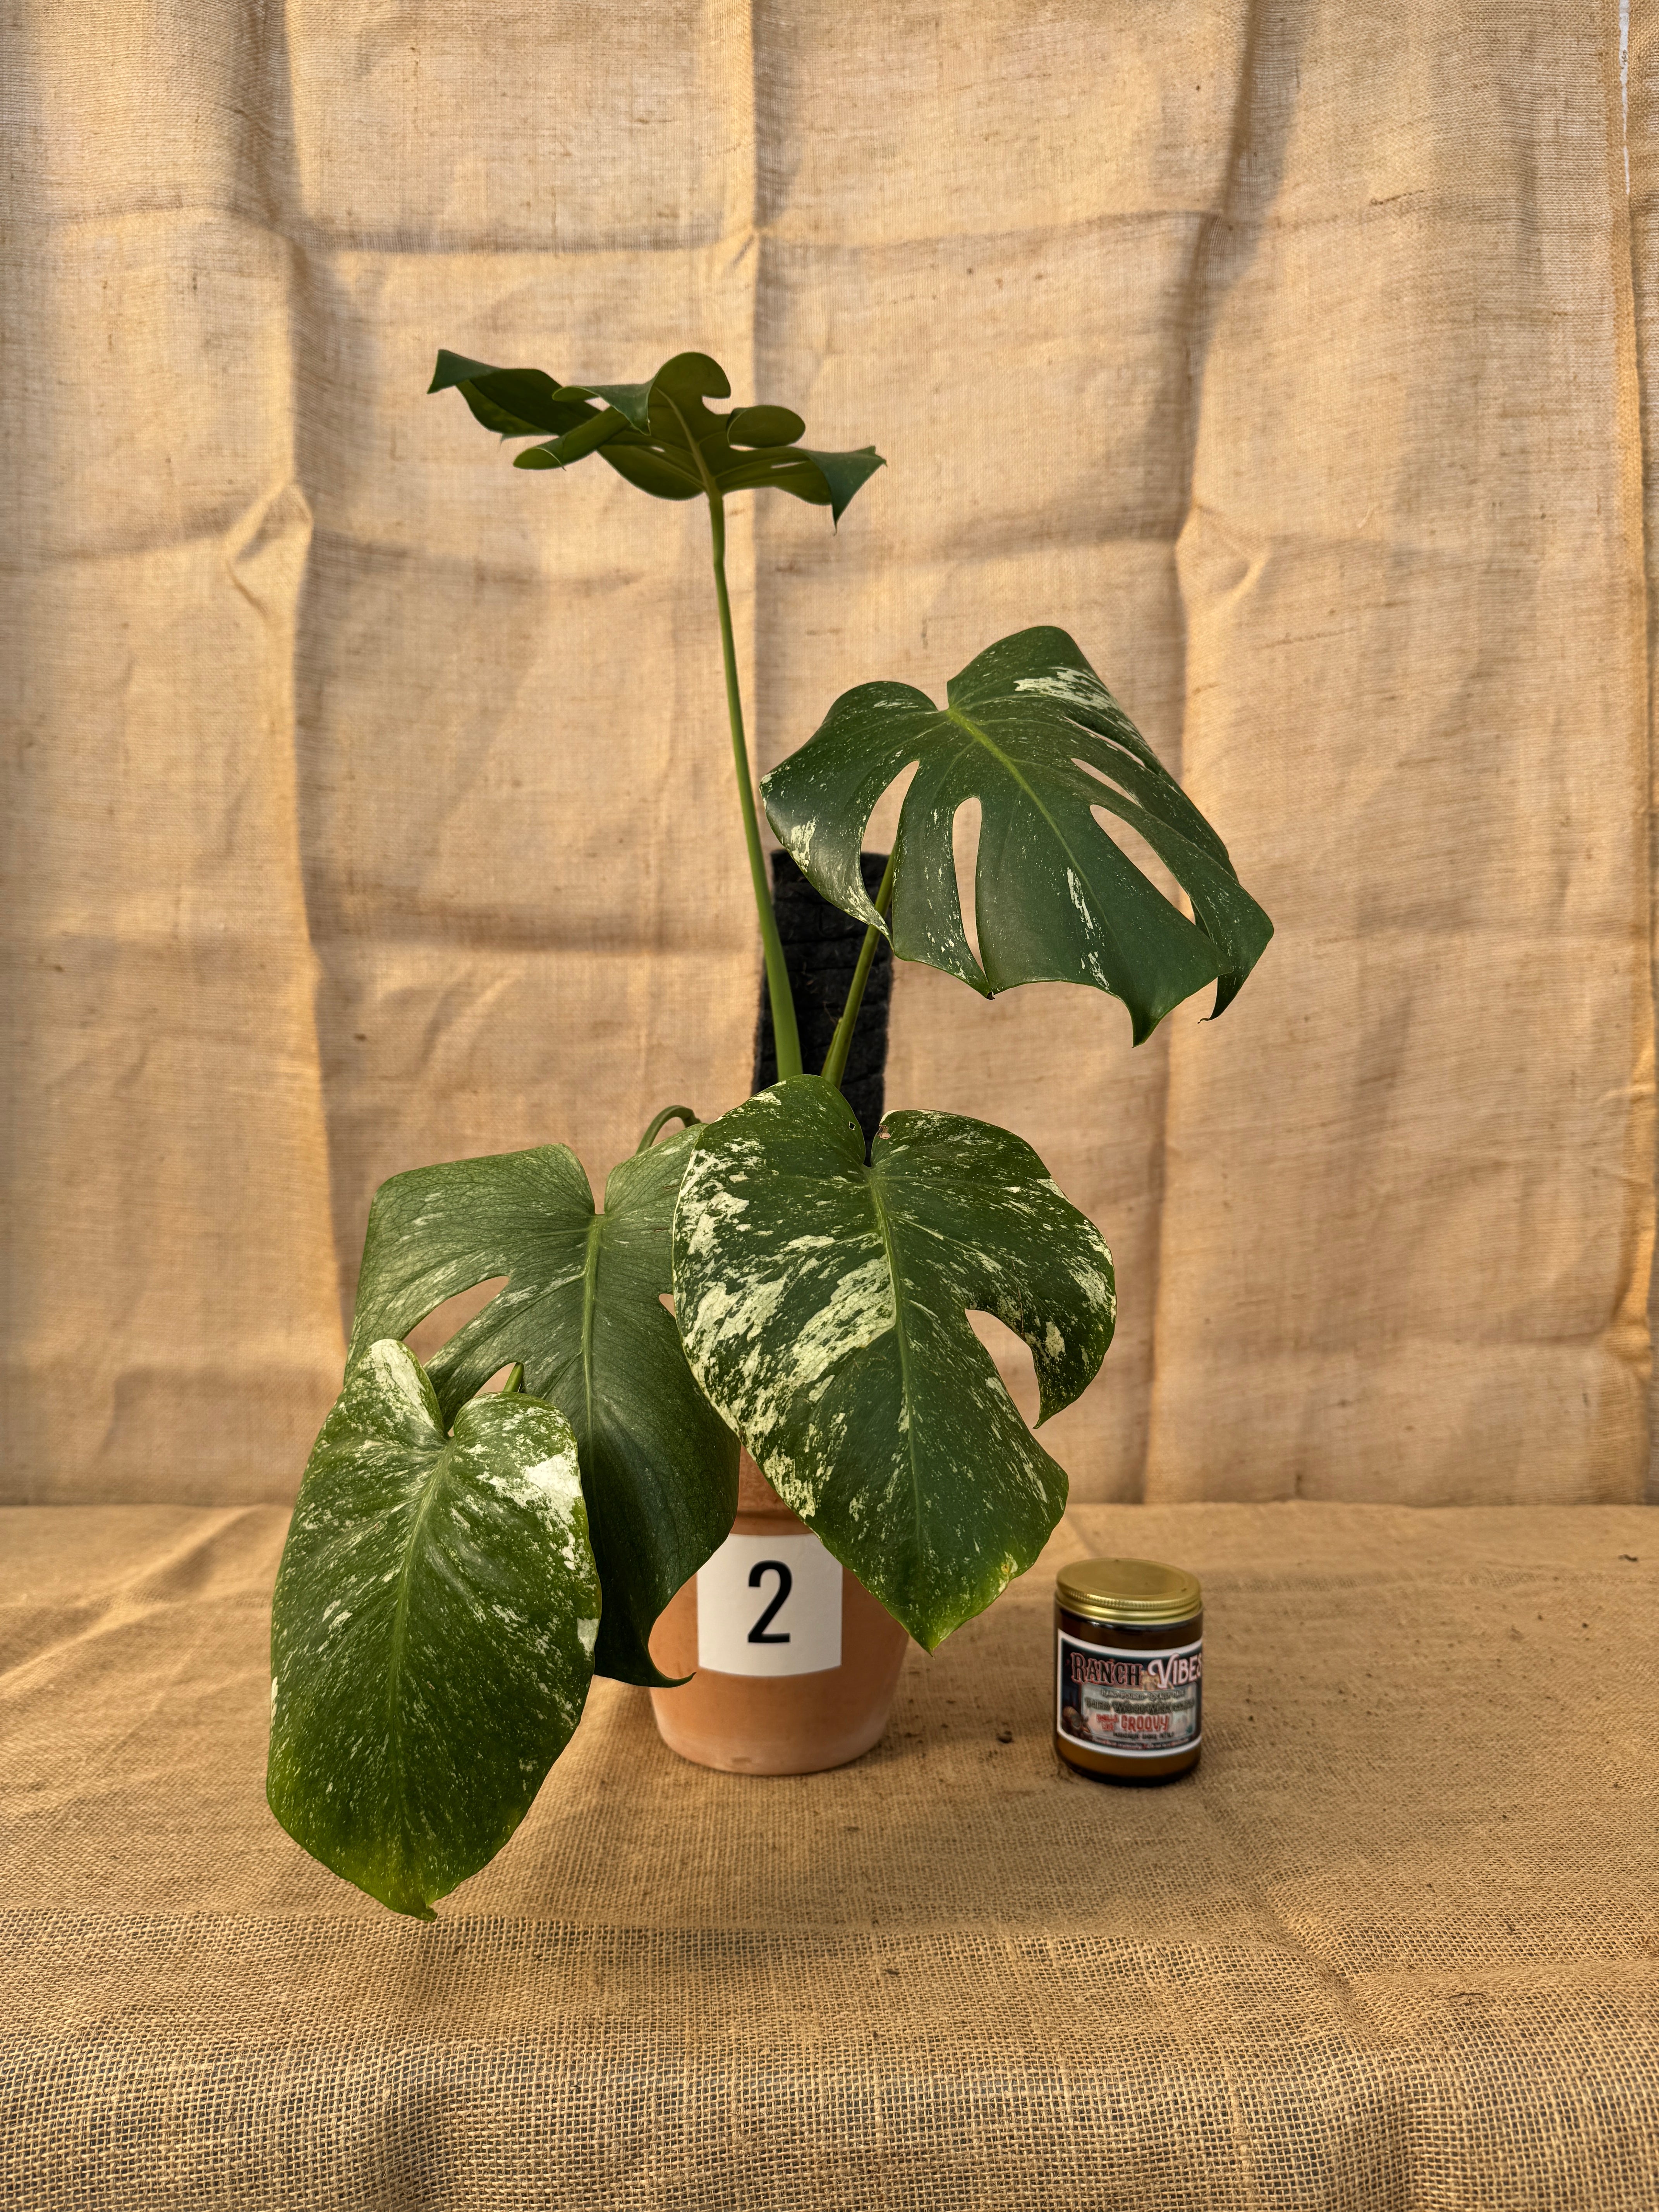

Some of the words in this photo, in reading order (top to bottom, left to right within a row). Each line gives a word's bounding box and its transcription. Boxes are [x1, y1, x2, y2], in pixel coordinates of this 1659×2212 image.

[748, 1559, 792, 1643] 2
[1070, 1652, 1143, 1686] RANCH
[1120, 1712, 1169, 1733] GROOVY
